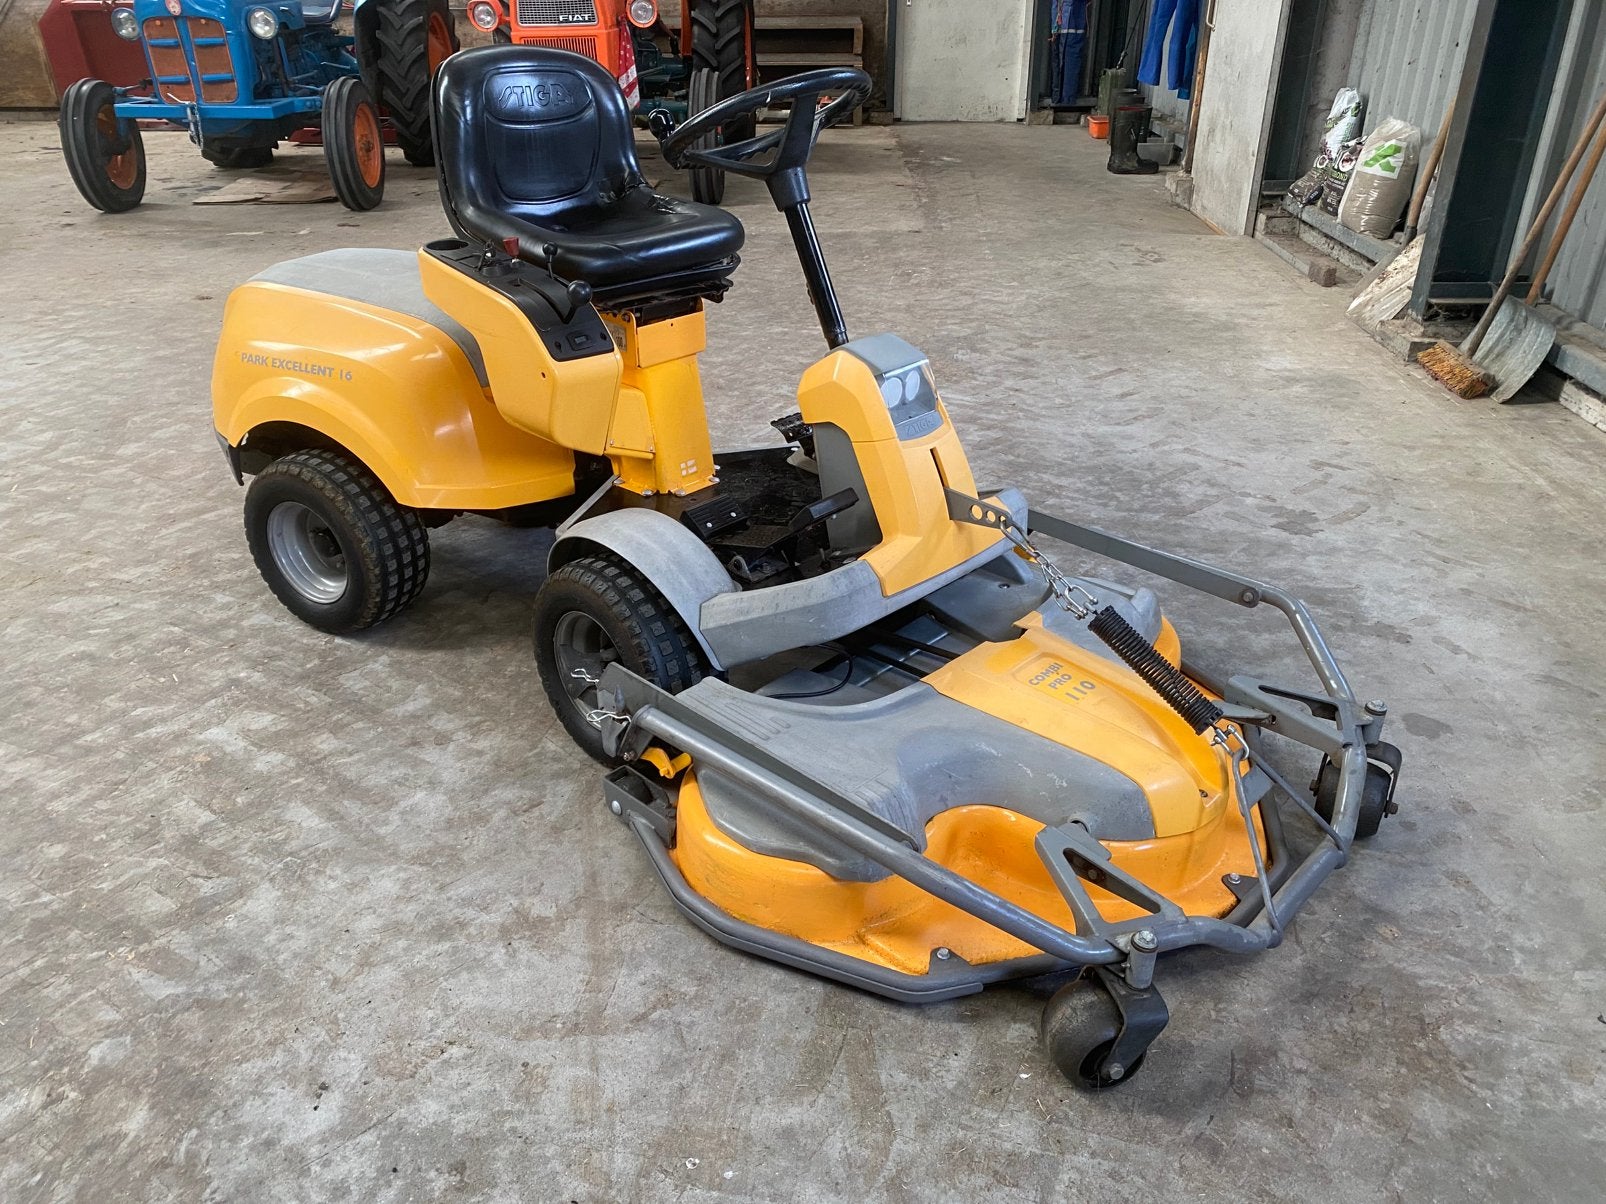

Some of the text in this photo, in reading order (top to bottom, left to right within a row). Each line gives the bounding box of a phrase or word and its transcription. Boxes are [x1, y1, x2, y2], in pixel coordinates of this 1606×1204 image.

[559, 14, 592, 22] FIAT
[499, 84, 574, 109] STIGA
[241, 352, 353, 381] PARK EXCELLENT 16
[1028, 662, 1064, 686] COMBI
[1048, 673, 1073, 690] PRO
[1065, 680, 1096, 701] 110
